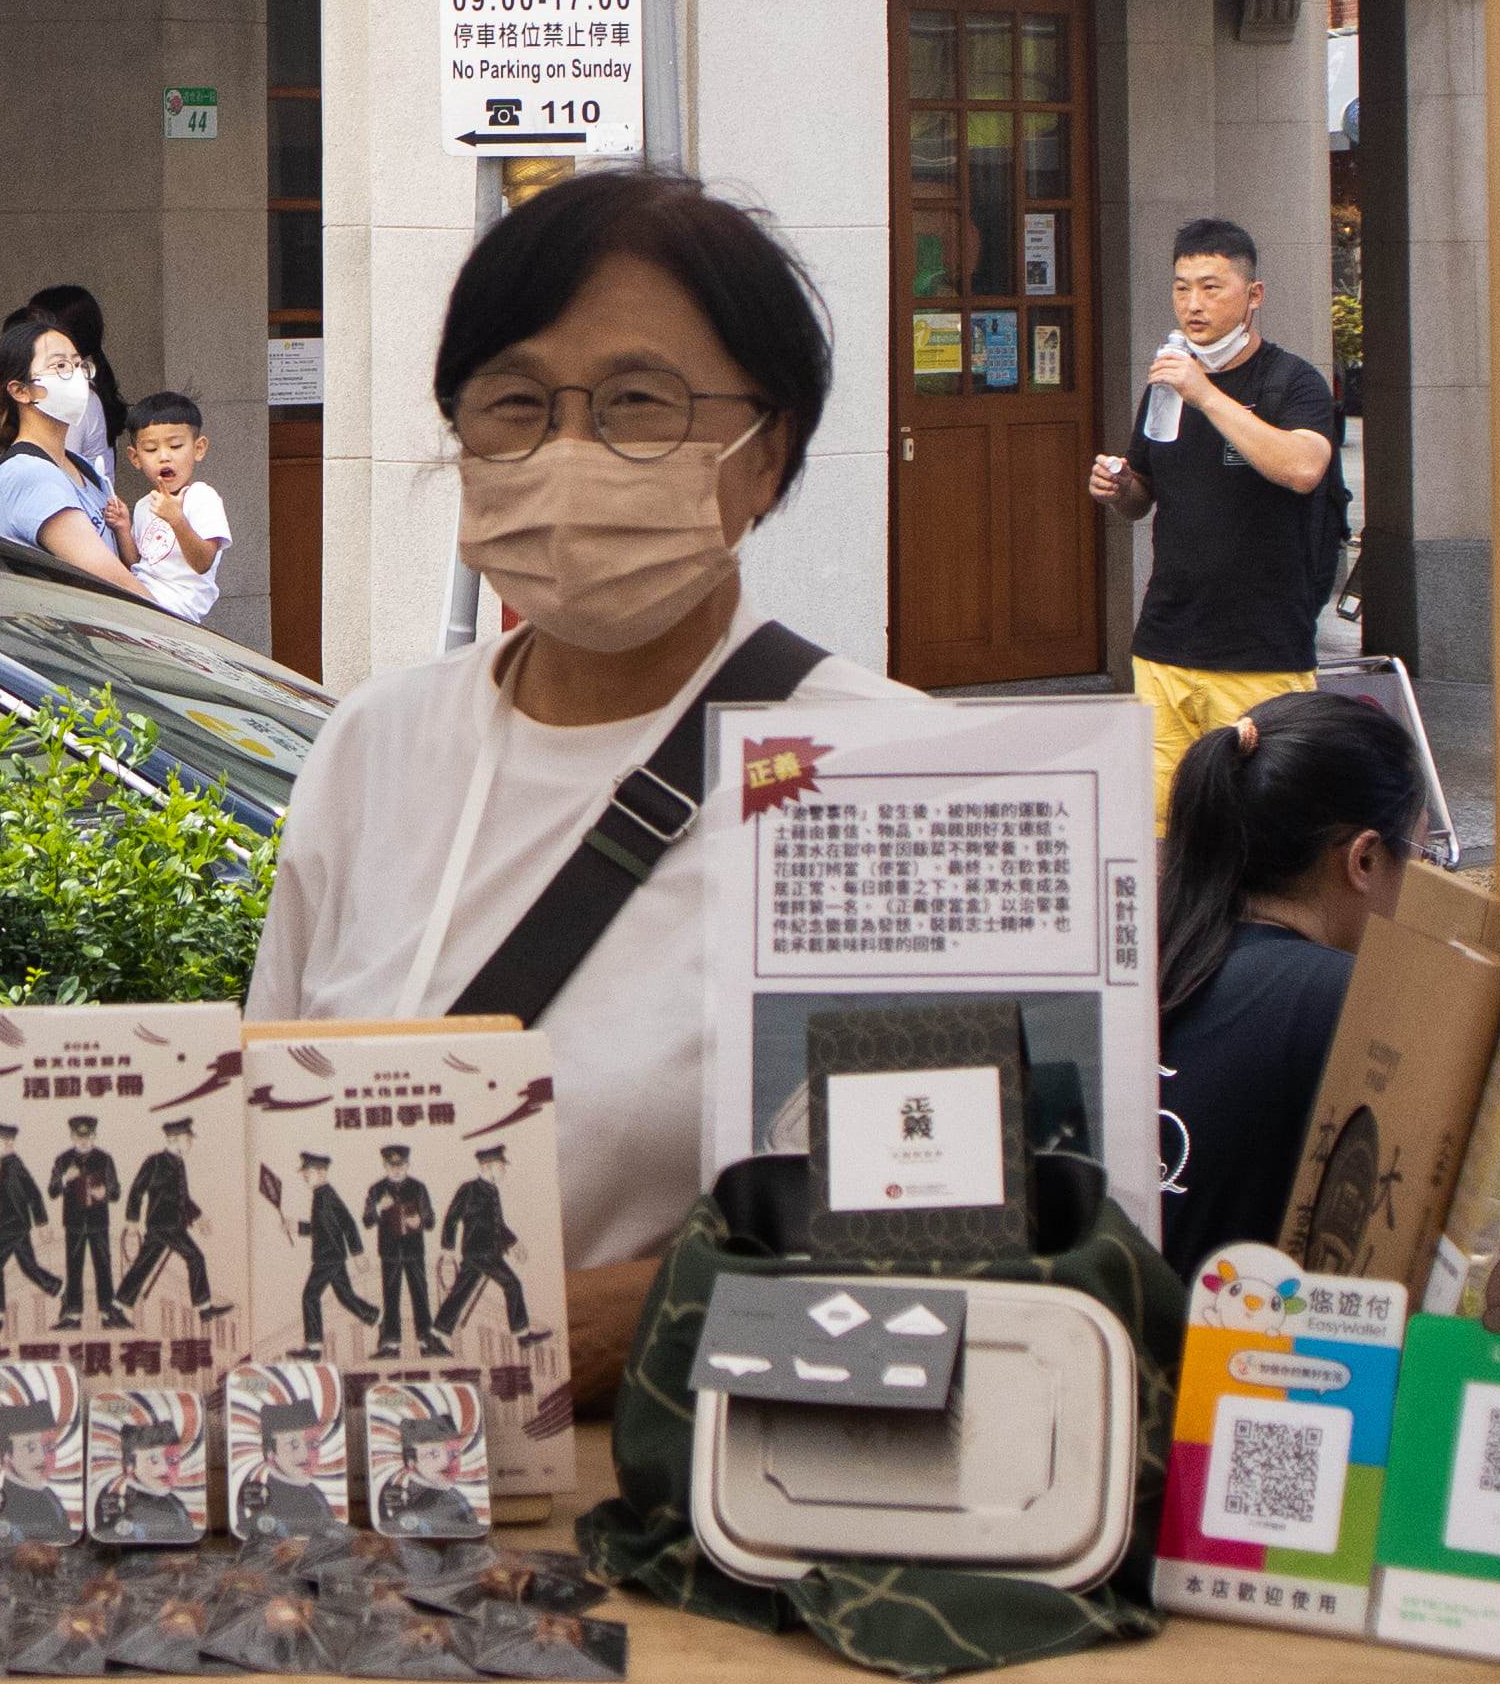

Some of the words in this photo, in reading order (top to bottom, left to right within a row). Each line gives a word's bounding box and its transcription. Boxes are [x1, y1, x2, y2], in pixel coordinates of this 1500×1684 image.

[454, 22, 630, 48] 停車格位禁止停車
[453, 59, 473, 79] No
[479, 59, 541, 83] Parking
[546, 64, 566, 79] on
[571, 59, 631, 82] Sunday
[188, 111, 207, 132] 44
[541, 100, 600, 124] 110
[747, 752, 802, 790] 正義
[1115, 875, 1138, 970] 設計說明
[22, 1074, 144, 1099] 活動手冊
[334, 1103, 455, 1130] 活動手冊
[1309, 1287, 1392, 1320] 悠遊付
[1307, 1317, 1388, 1339] EasyWallet
[1185, 1574, 1337, 1616] 本店歡迎使用
